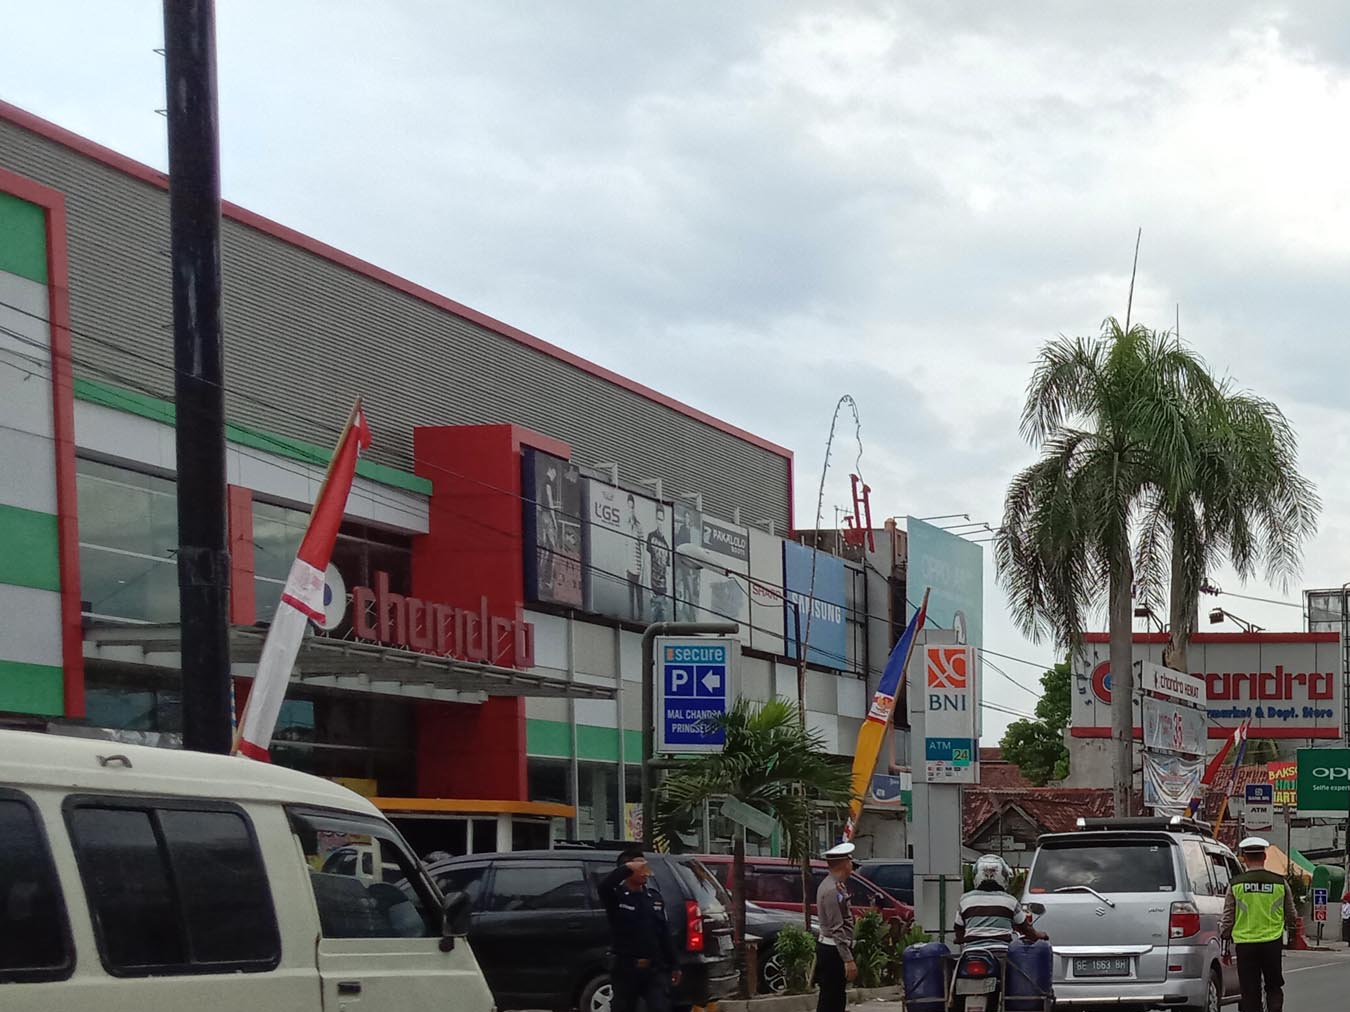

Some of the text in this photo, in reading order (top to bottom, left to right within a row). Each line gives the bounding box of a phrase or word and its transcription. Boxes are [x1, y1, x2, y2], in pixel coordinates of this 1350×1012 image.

[791, 593, 842, 625] SAMSUNG
[671, 669, 689, 692] P
[928, 694, 967, 711] BNI
[667, 709, 685, 719] MAL
[1302, 706, 1334, 719] Store
[929, 741, 951, 751] ATM
[953, 749, 969, 762] 24
[1244, 882, 1274, 893] POLISI
